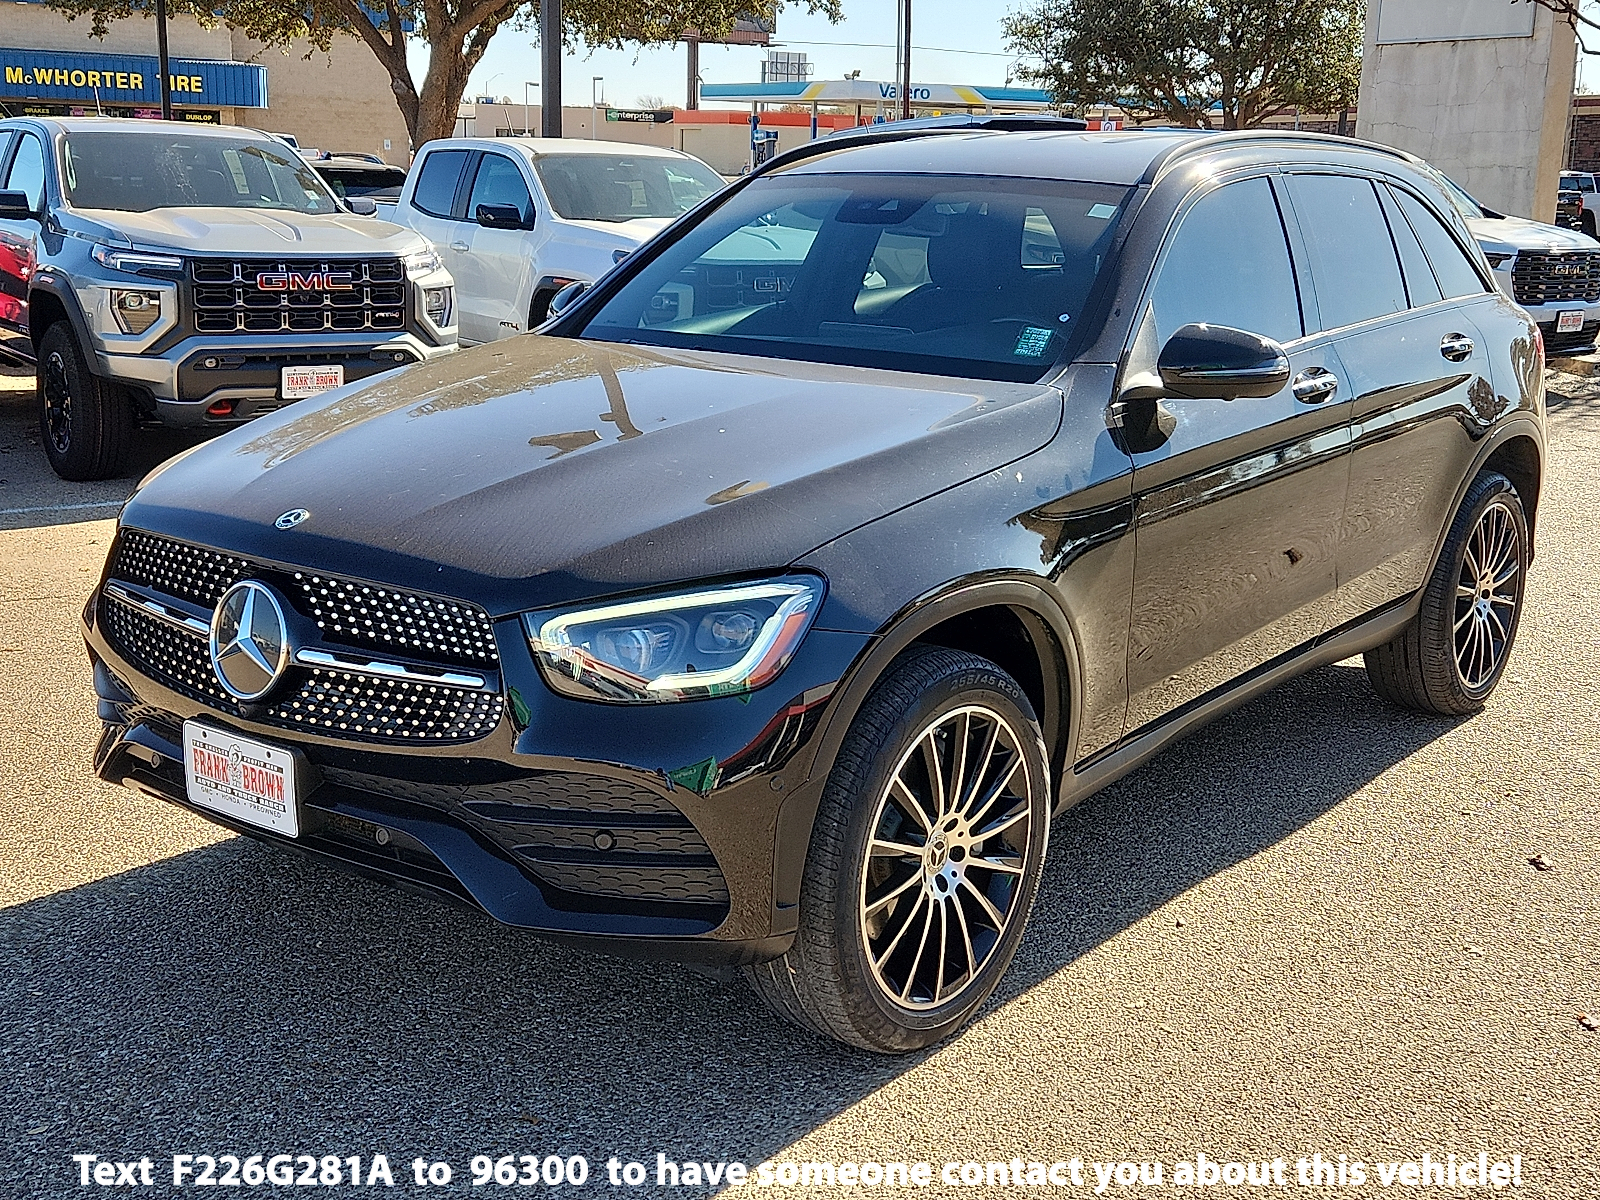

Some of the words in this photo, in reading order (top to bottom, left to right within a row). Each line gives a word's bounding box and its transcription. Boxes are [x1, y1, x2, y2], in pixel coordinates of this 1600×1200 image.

[5, 67, 143, 90] McWHORTER
[609, 111, 655, 121] enterprise
[257, 272, 353, 291] GMC
[997, 680, 1019, 699] R20
[193, 748, 229, 783] FRANK
[241, 764, 285, 803] BROWN
[200, 786, 213, 796] GMC
[221, 793, 241, 805] HONDA
